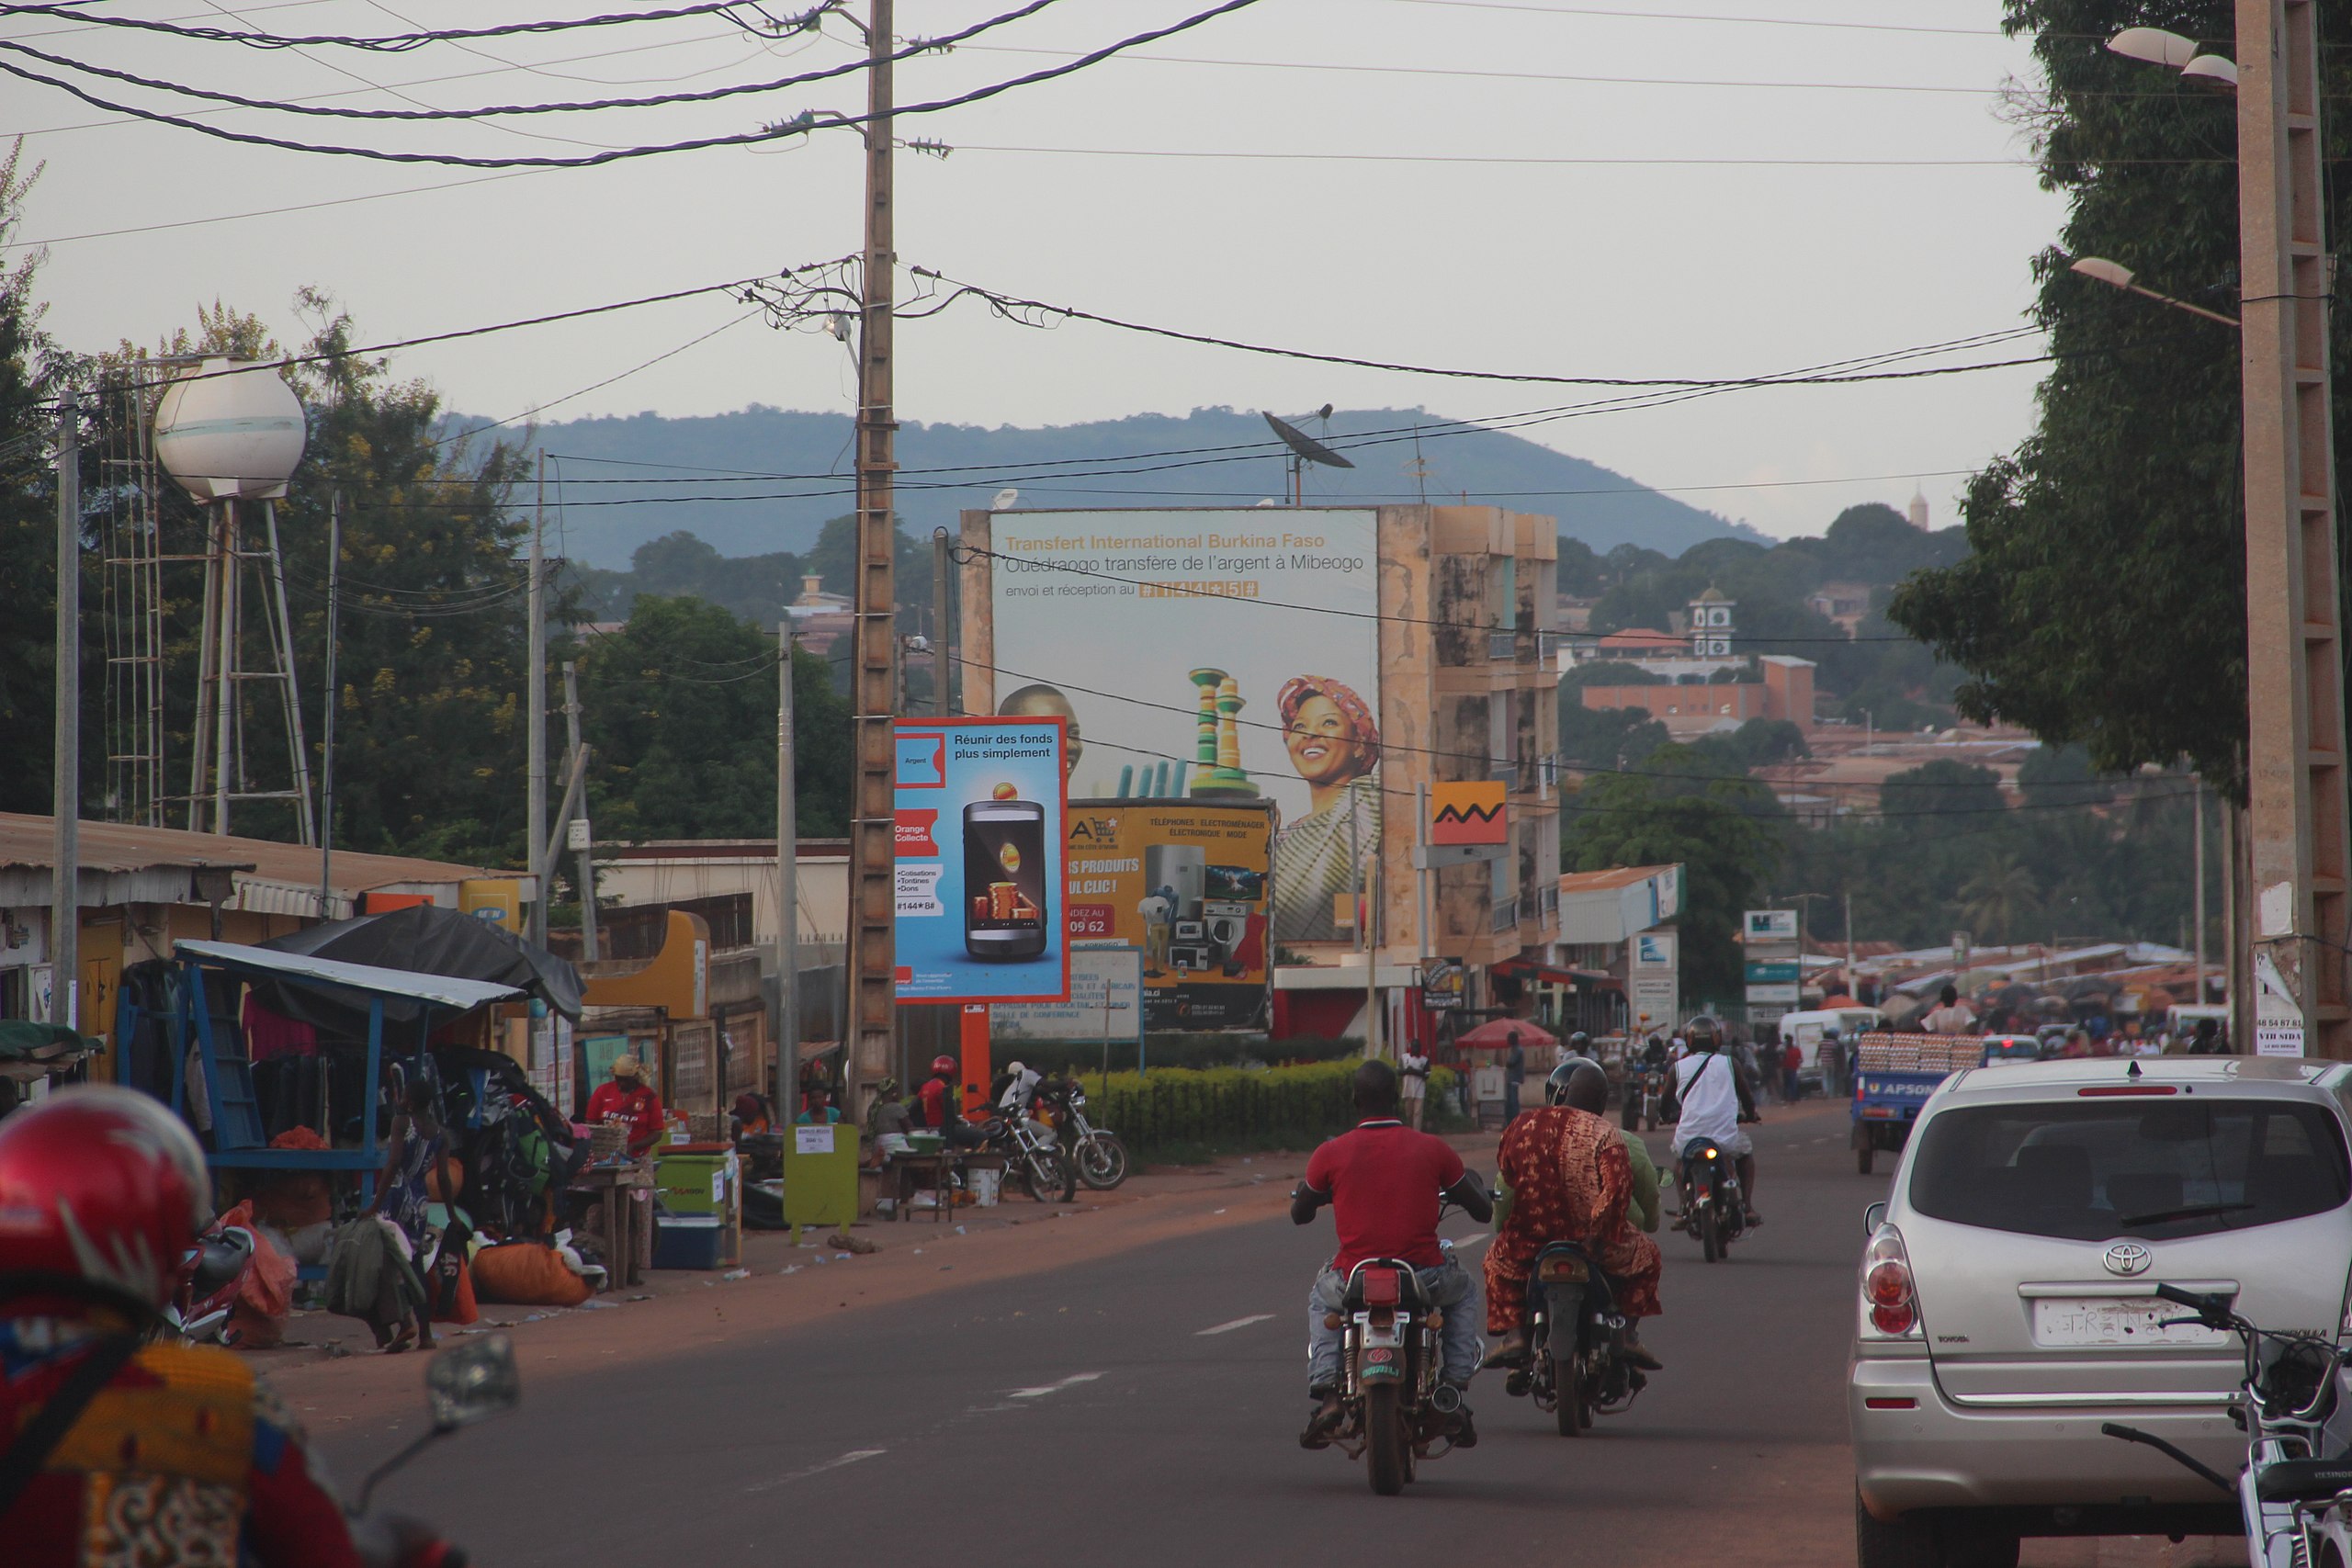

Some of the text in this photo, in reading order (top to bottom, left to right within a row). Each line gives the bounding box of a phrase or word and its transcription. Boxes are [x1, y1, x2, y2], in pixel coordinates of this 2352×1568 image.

[1005, 533, 1325, 551] Transfert International Burkina Faso
[1006, 557, 1100, 573] Ouédraogo
[1105, 555, 1177, 570] transfère
[1182, 555, 1204, 570] de
[1275, 555, 1285, 570] à
[1291, 554, 1363, 573] Mibeogo
[1006, 585, 1039, 597] envoi
[1043, 585, 1054, 596] et
[1058, 583, 1115, 598] réception
[1119, 585, 1135, 595] au
[955, 733, 1053, 745] Réunir des fonds
[955, 748, 1050, 761] plus simplement
[895, 825, 925, 834] Orange
[1227, 829, 1248, 839] MODE
[895, 833, 929, 841] Collecte
[1081, 858, 1139, 874] PRODUITS
[1084, 880, 1111, 894] CLIC
[1092, 908, 1104, 917] AU
[1089, 920, 1104, 932] 62
